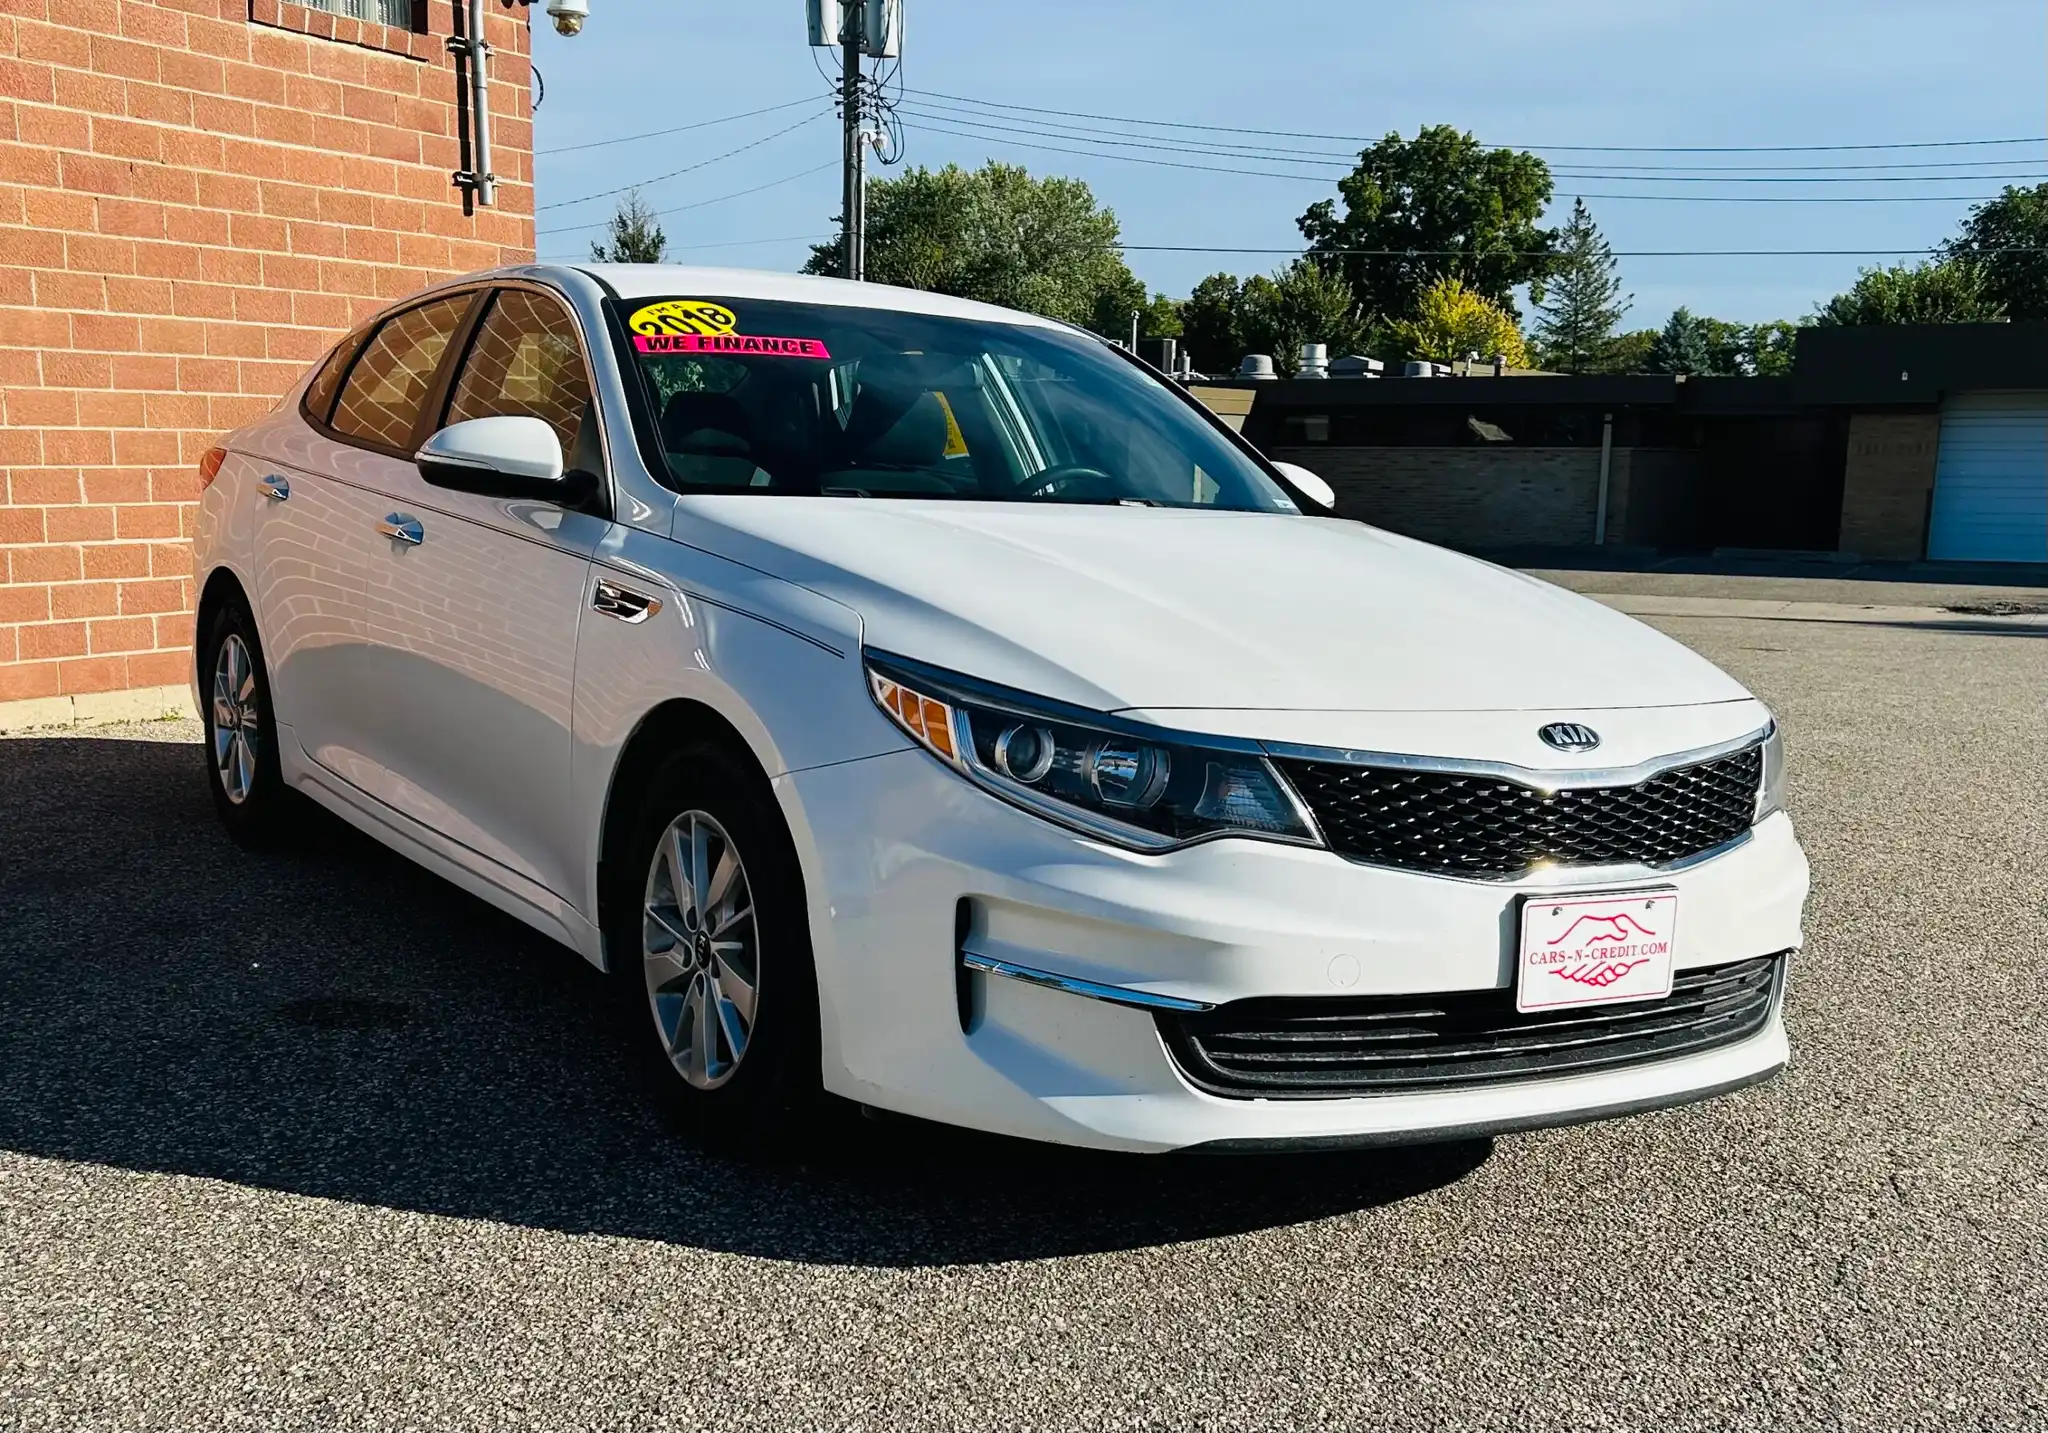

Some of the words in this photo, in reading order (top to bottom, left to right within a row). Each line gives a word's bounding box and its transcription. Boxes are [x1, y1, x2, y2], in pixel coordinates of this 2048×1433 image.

[638, 306, 733, 336] 2018
[645, 336, 687, 351] WE
[697, 336, 815, 354] FINANCE
[1546, 725, 1597, 744] KIA
[1529, 941, 1668, 966] CARS-N-CREDIT.COM
